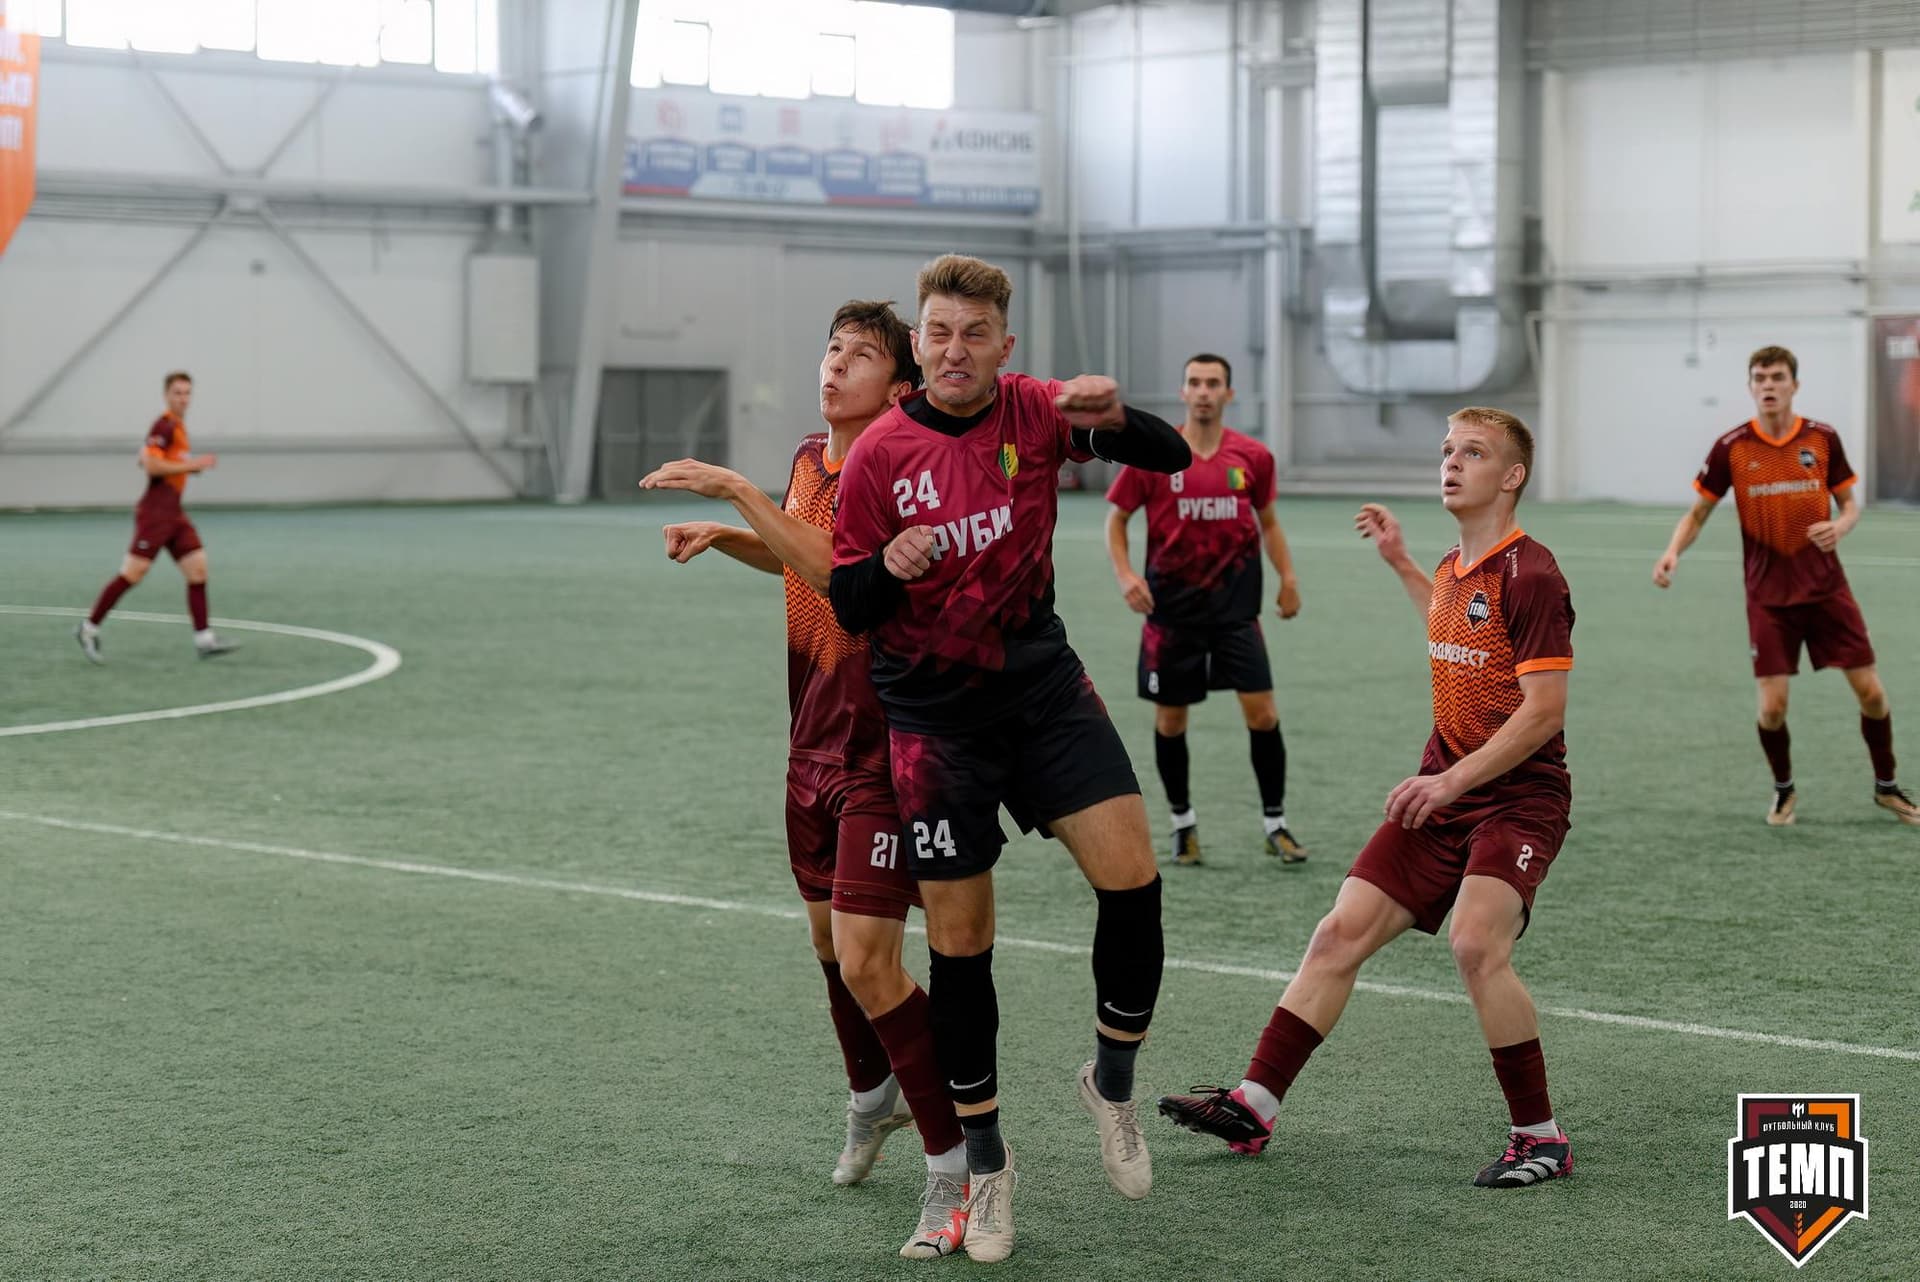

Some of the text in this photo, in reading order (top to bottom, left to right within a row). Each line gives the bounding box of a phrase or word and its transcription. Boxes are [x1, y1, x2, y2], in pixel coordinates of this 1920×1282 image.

[893, 470, 941, 518] 24
[932, 498, 1014, 561] РУБИ
[870, 832, 898, 870] 21
[913, 819, 957, 858] 24
[1516, 844, 1533, 872] 2
